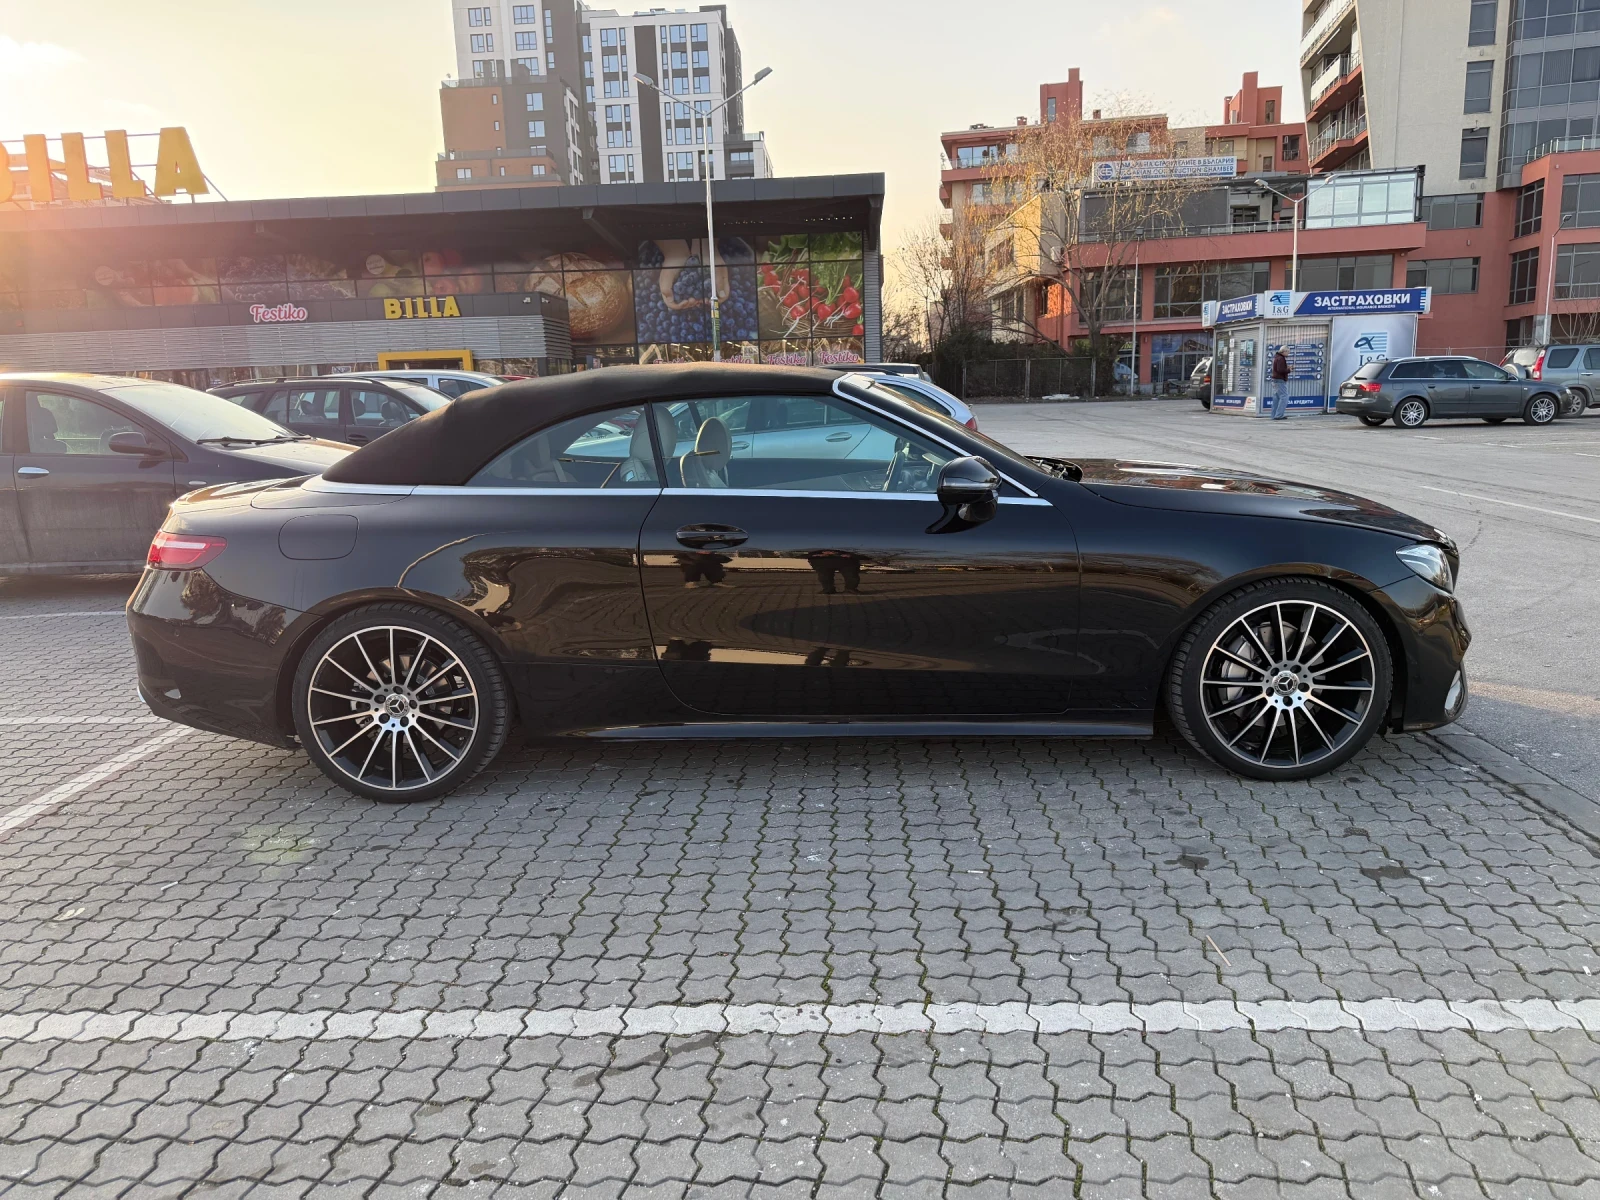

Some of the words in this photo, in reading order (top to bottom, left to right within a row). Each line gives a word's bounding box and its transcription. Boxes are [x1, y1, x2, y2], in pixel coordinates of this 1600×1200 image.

[1203, 165, 1234, 173] CHAMBER
[384, 295, 460, 319] BILLA
[1222, 300, 1252, 314] ЗАСТРАХОВКИ
[1314, 293, 1410, 307] ЗАСТРАХОВКИ
[249, 303, 307, 322] Festiko
[767, 353, 807, 365] Festiko
[820, 350, 859, 363] Festiko
